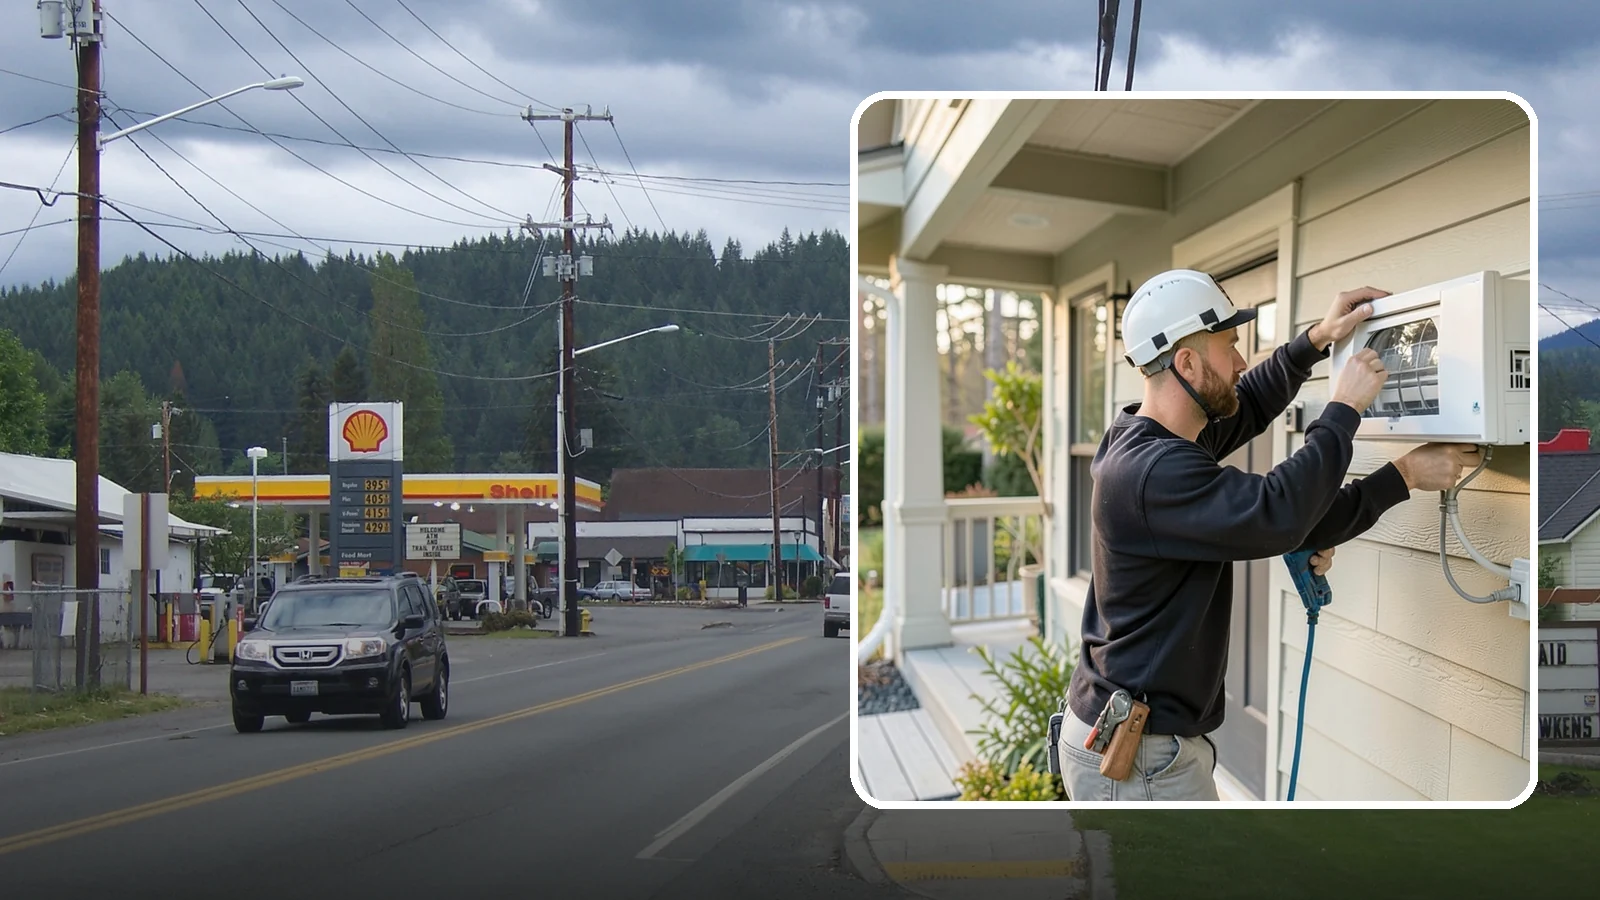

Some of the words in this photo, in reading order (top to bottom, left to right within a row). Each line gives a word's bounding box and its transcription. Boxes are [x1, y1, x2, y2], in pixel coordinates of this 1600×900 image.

[366, 480, 384, 490] 395
[490, 484, 547, 499] Shell
[366, 494, 384, 504] 405
[366, 508, 384, 518] 415
[366, 522, 384, 532] 429
